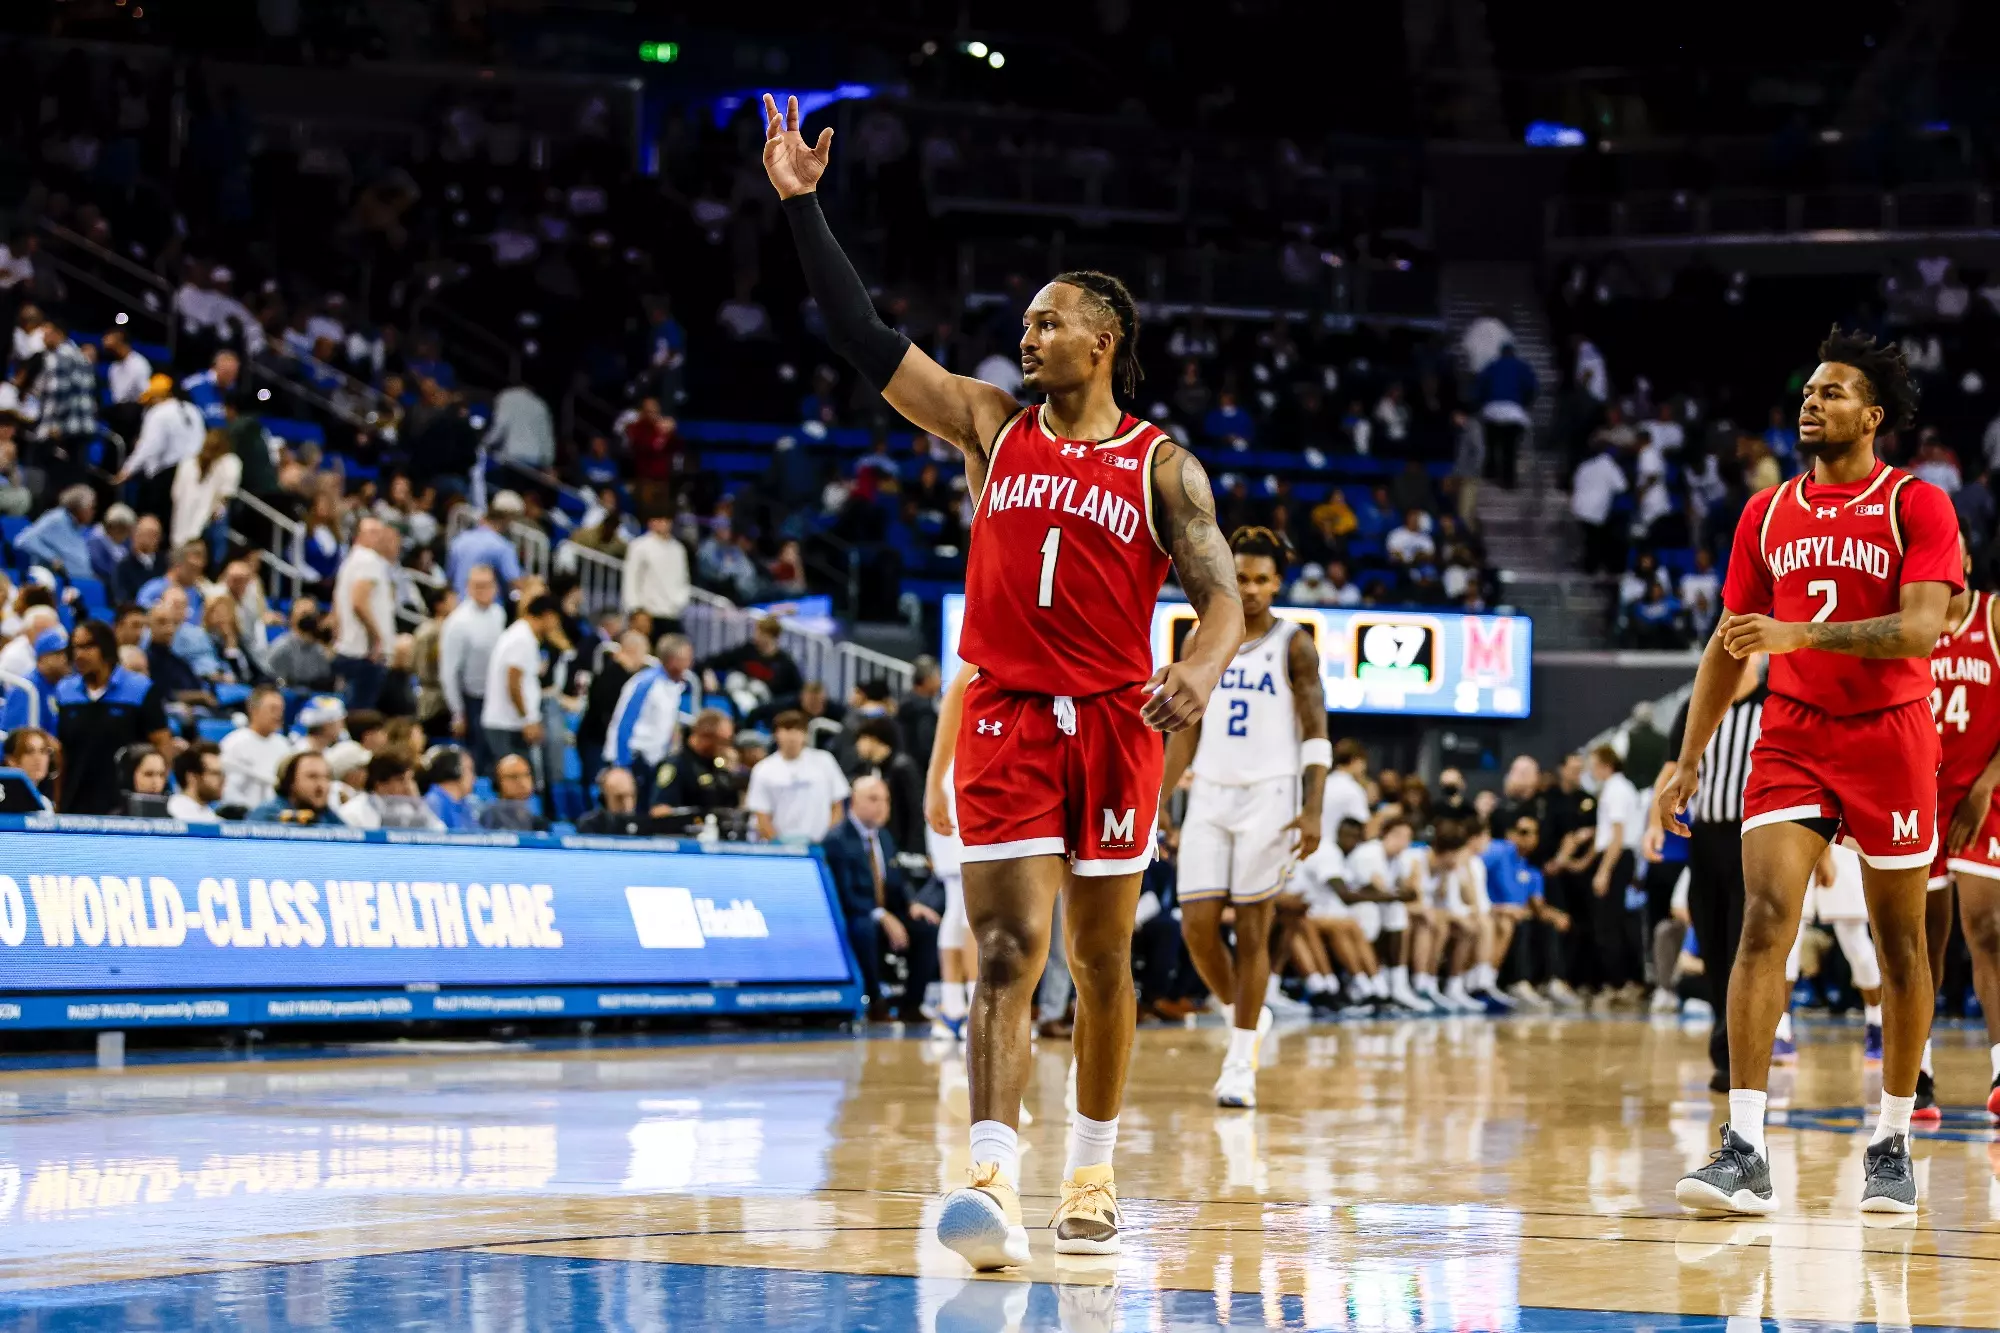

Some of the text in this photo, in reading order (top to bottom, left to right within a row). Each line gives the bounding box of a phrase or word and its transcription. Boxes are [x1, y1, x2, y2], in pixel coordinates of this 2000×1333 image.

[987, 473, 1140, 544] MARYLAND
[1038, 527, 1061, 607] 1
[1768, 536, 1890, 581] MARYLAND
[1807, 579, 1838, 623] 2
[1213, 668, 1276, 695] CLA
[1931, 656, 1991, 686] YLAND
[1228, 699, 1248, 736] 2
[1100, 808, 1136, 842] M
[1891, 809, 1919, 841] M
[28, 875, 327, 948] WORLD-CLASS
[325, 880, 468, 948] HEALTH
[466, 883, 563, 948] CARE
